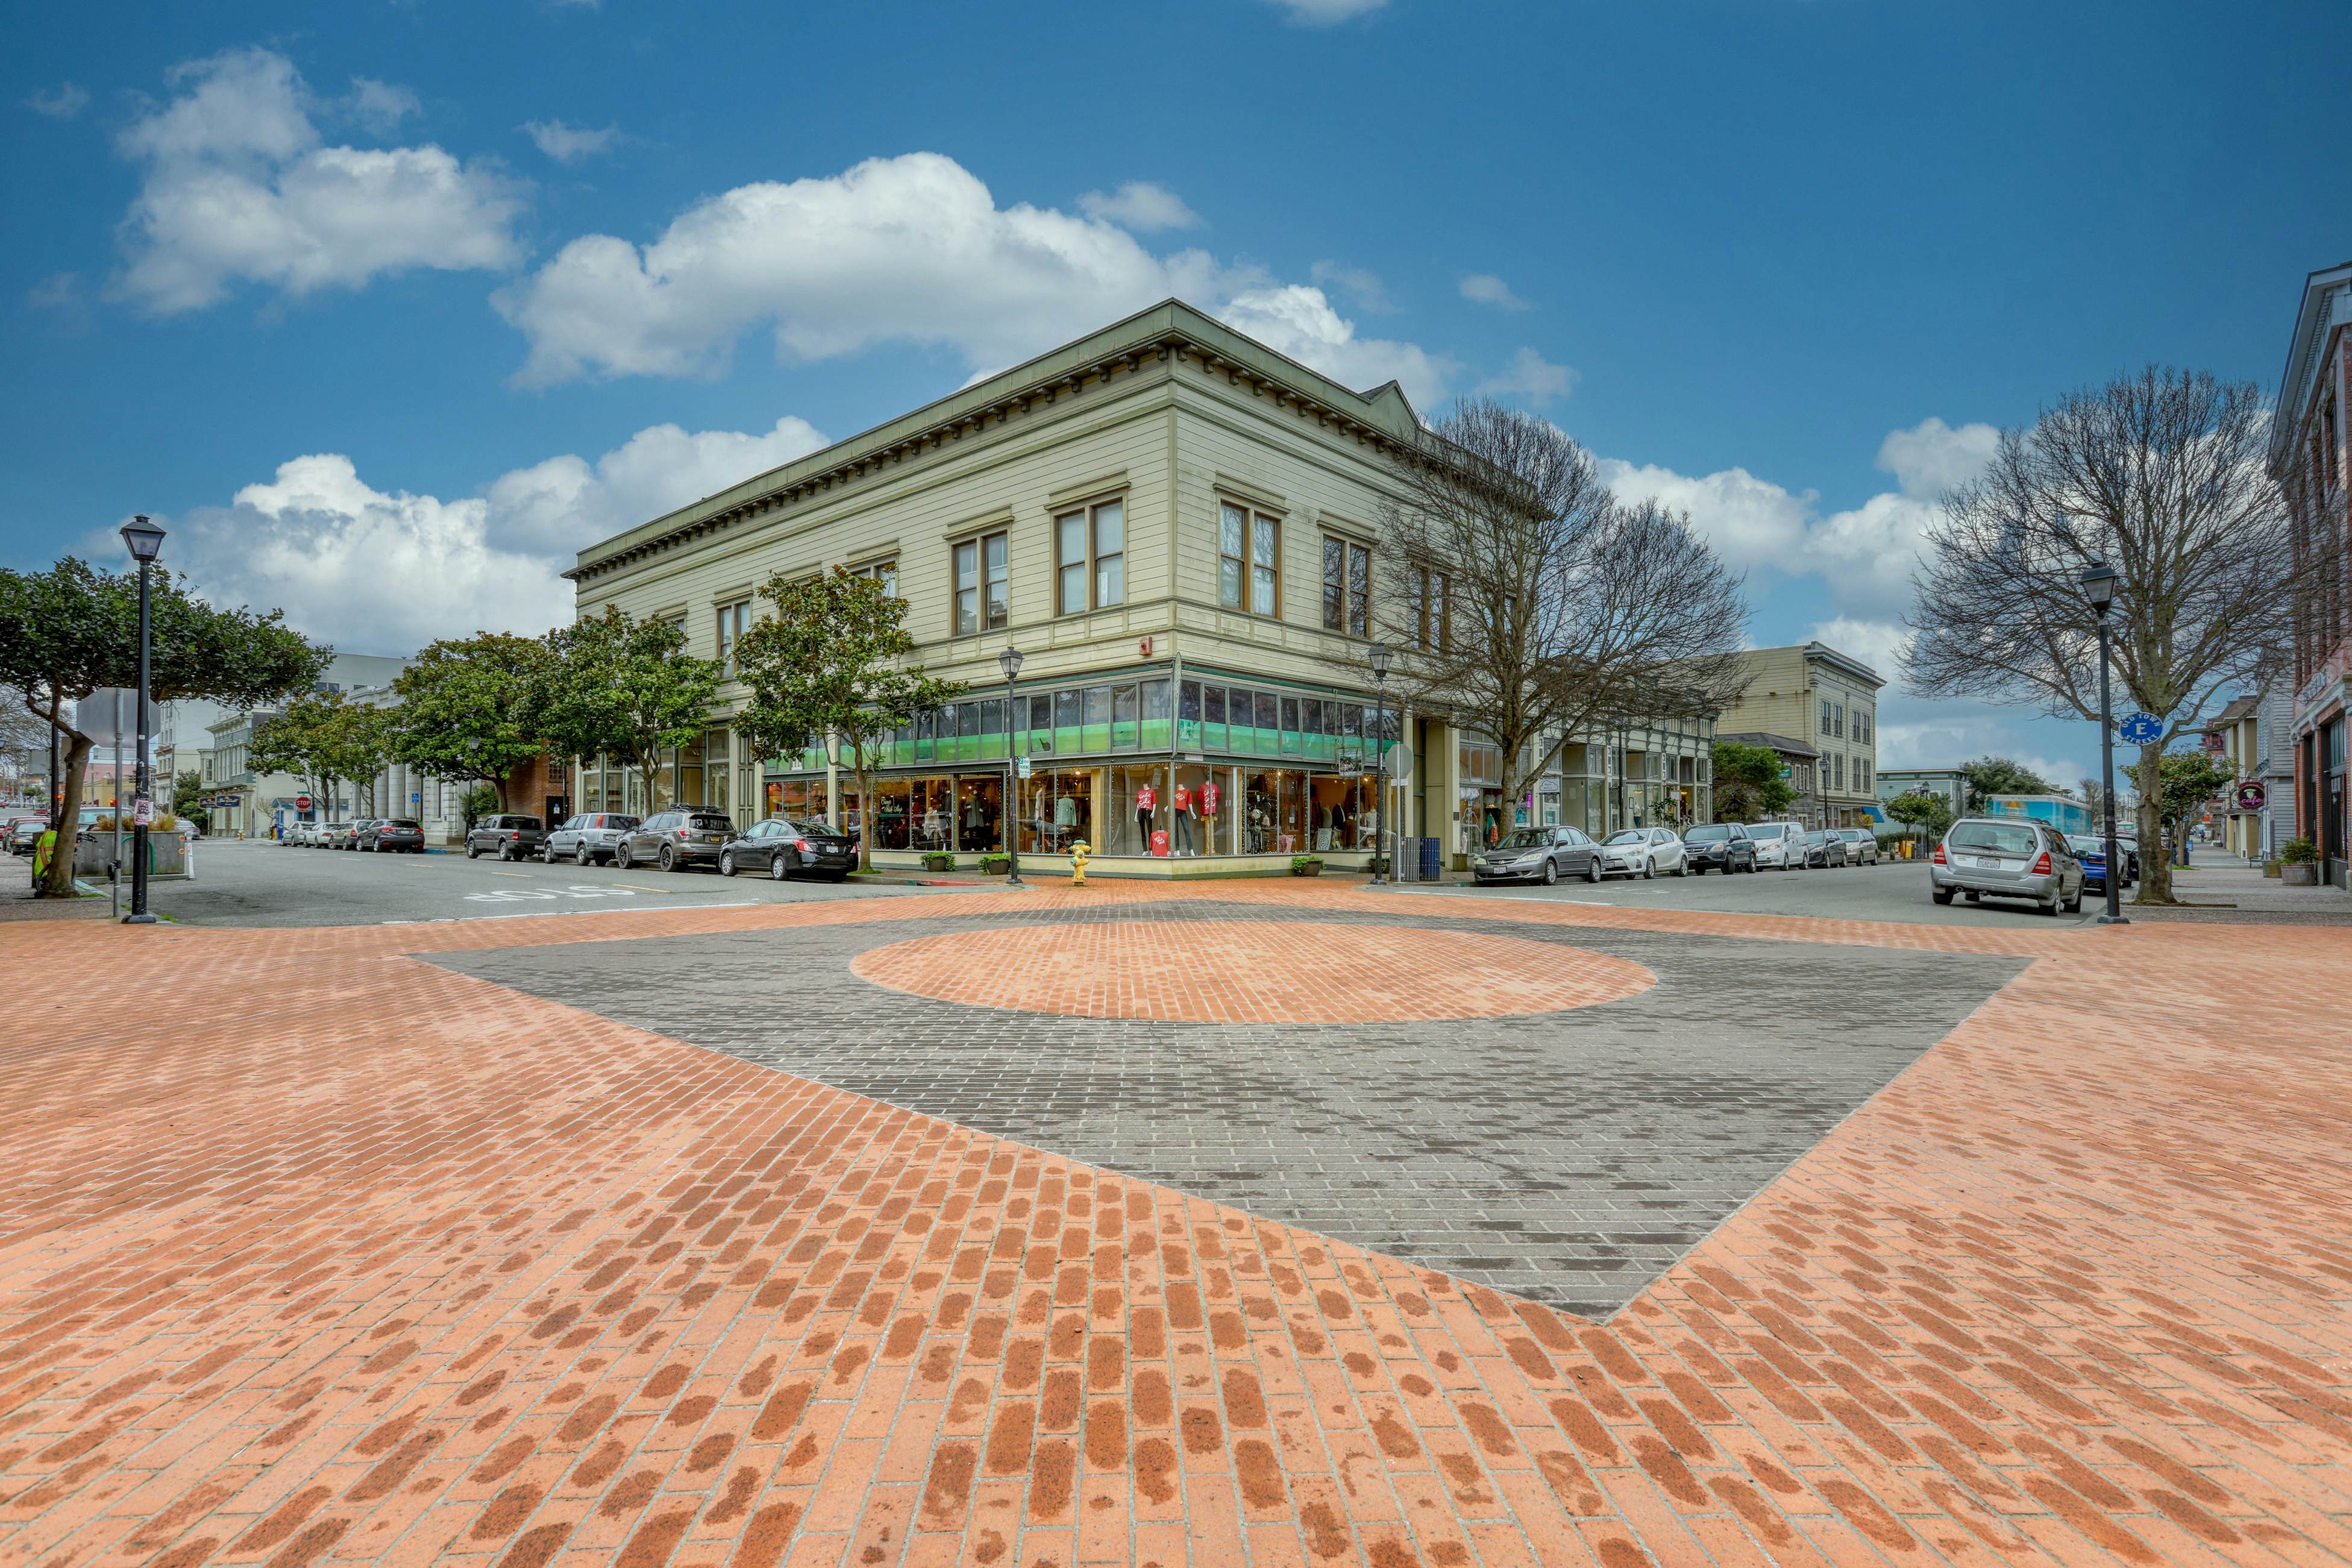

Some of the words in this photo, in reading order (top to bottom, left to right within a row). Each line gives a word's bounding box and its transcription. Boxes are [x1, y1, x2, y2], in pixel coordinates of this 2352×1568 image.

[2122, 716, 2135, 728] OLD
[2139, 713, 2161, 727] TOWN
[2135, 723, 2147, 735] E
[2125, 734, 2157, 744] STREET
[2241, 795, 2263, 805] cafe
